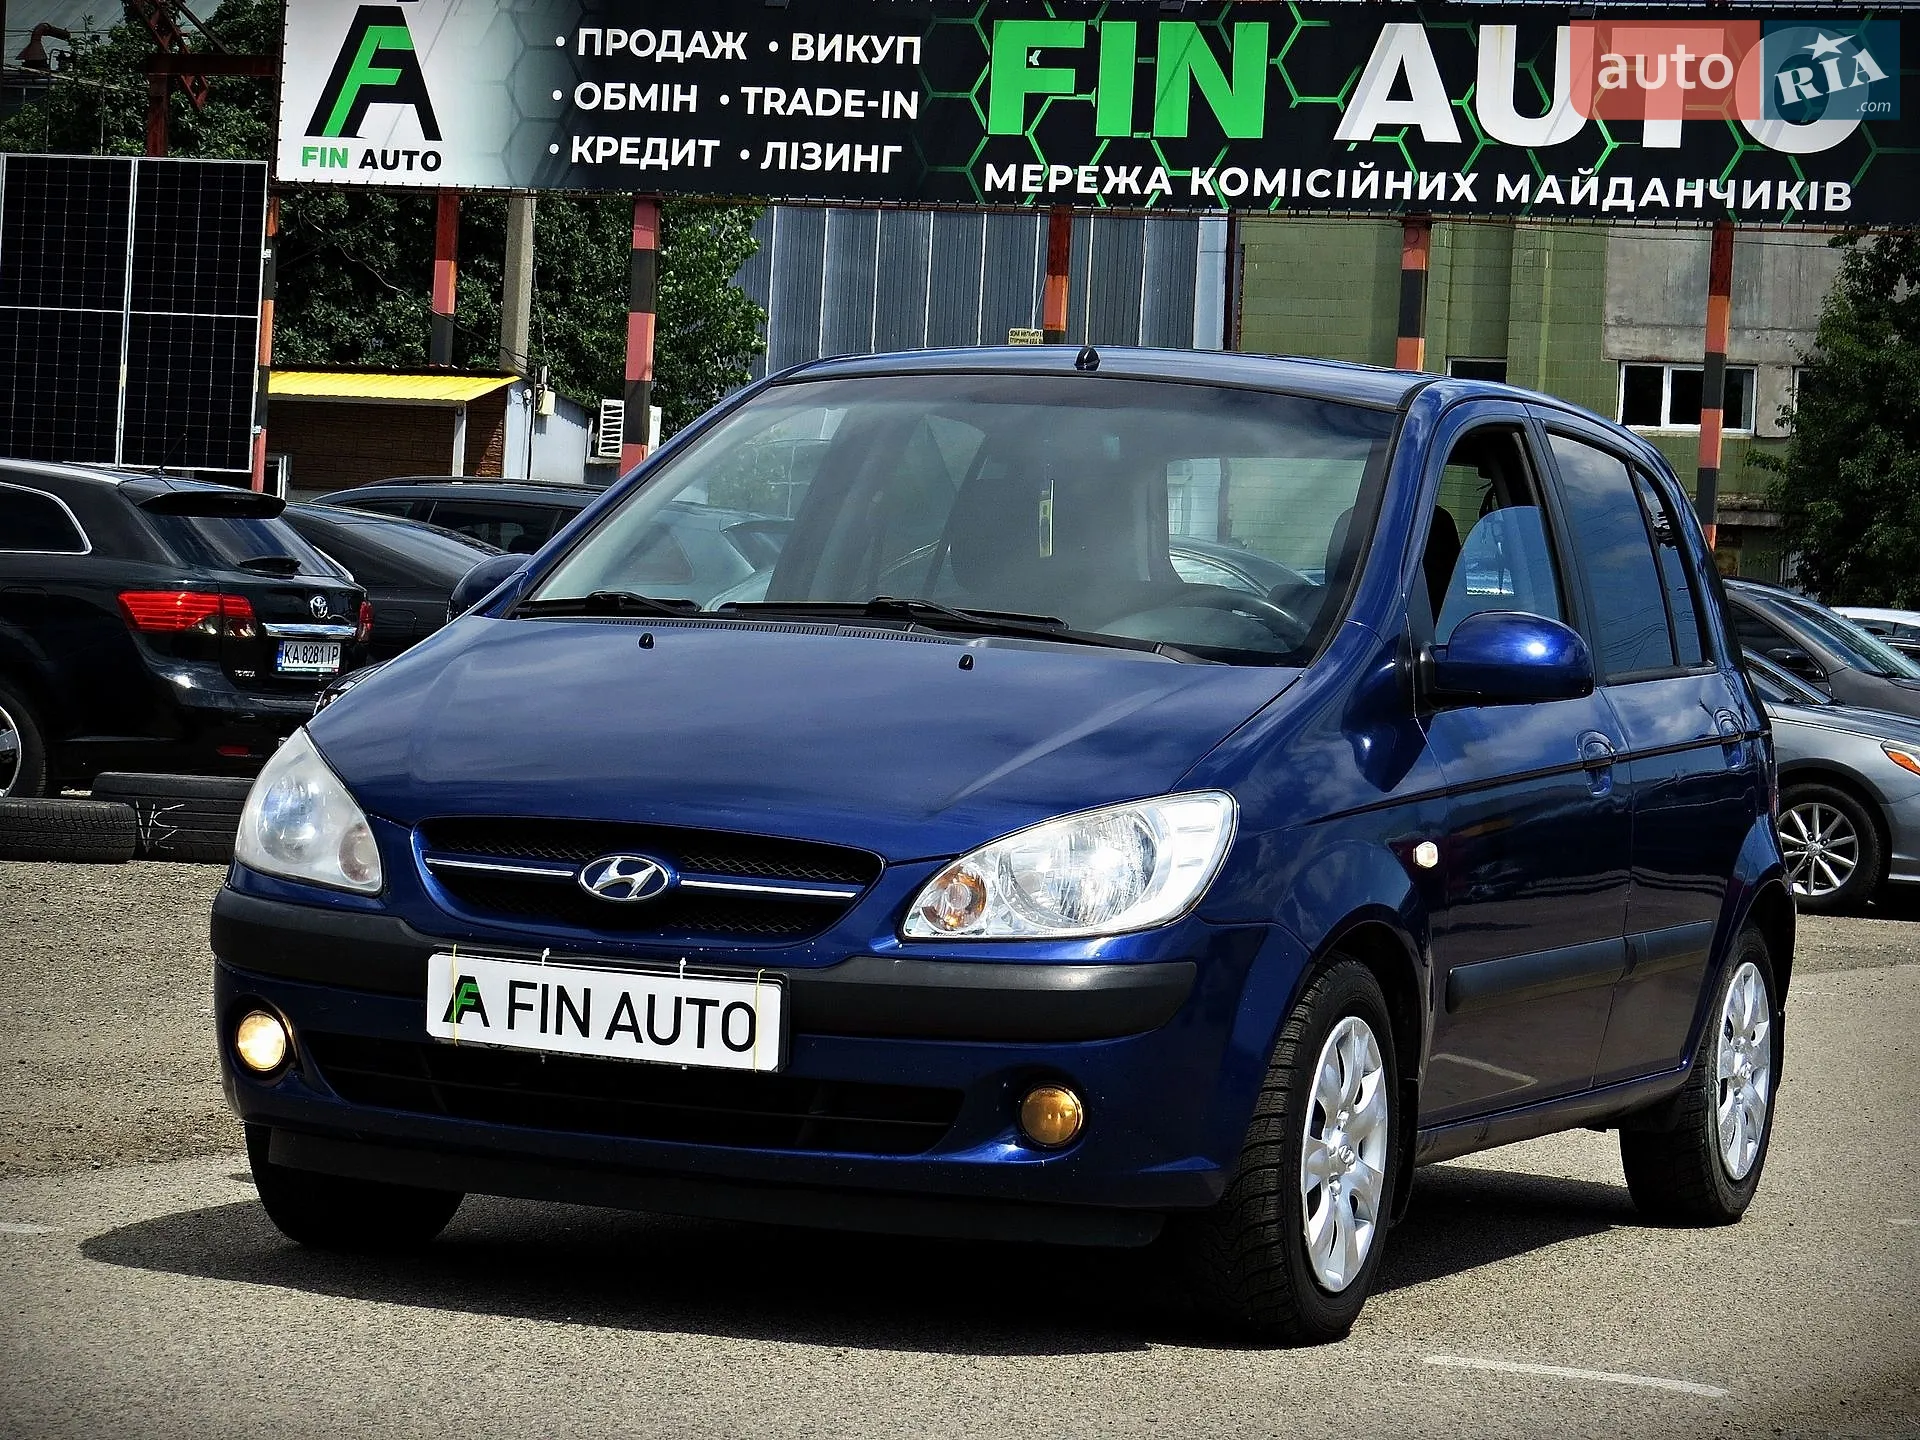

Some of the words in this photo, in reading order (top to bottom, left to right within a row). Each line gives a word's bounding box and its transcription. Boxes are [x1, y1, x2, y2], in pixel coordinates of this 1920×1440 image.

[577, 28, 748, 63] ПРОДАЖ
[791, 32, 921, 65] ВИКУП
[573, 81, 698, 113] ОБМІН
[740, 86, 919, 120] TRADE-IN
[987, 20, 1270, 139] FIN
[1333, 22, 1870, 154] AUTO
[301, 146, 349, 169] FIN
[358, 148, 442, 172] AUTO
[571, 135, 721, 171] КРЕДИТ
[760, 140, 903, 174] ЛІЗИНГ
[984, 162, 1174, 196] МЕРЕЖА
[1190, 161, 1479, 203] КОМІСІЙНИХ
[1496, 166, 1852, 213] МАЙДАНЧИКІВ
[302, 644, 324, 665] 8281
[507, 978, 592, 1039] FIN
[604, 990, 757, 1053] AUTO
